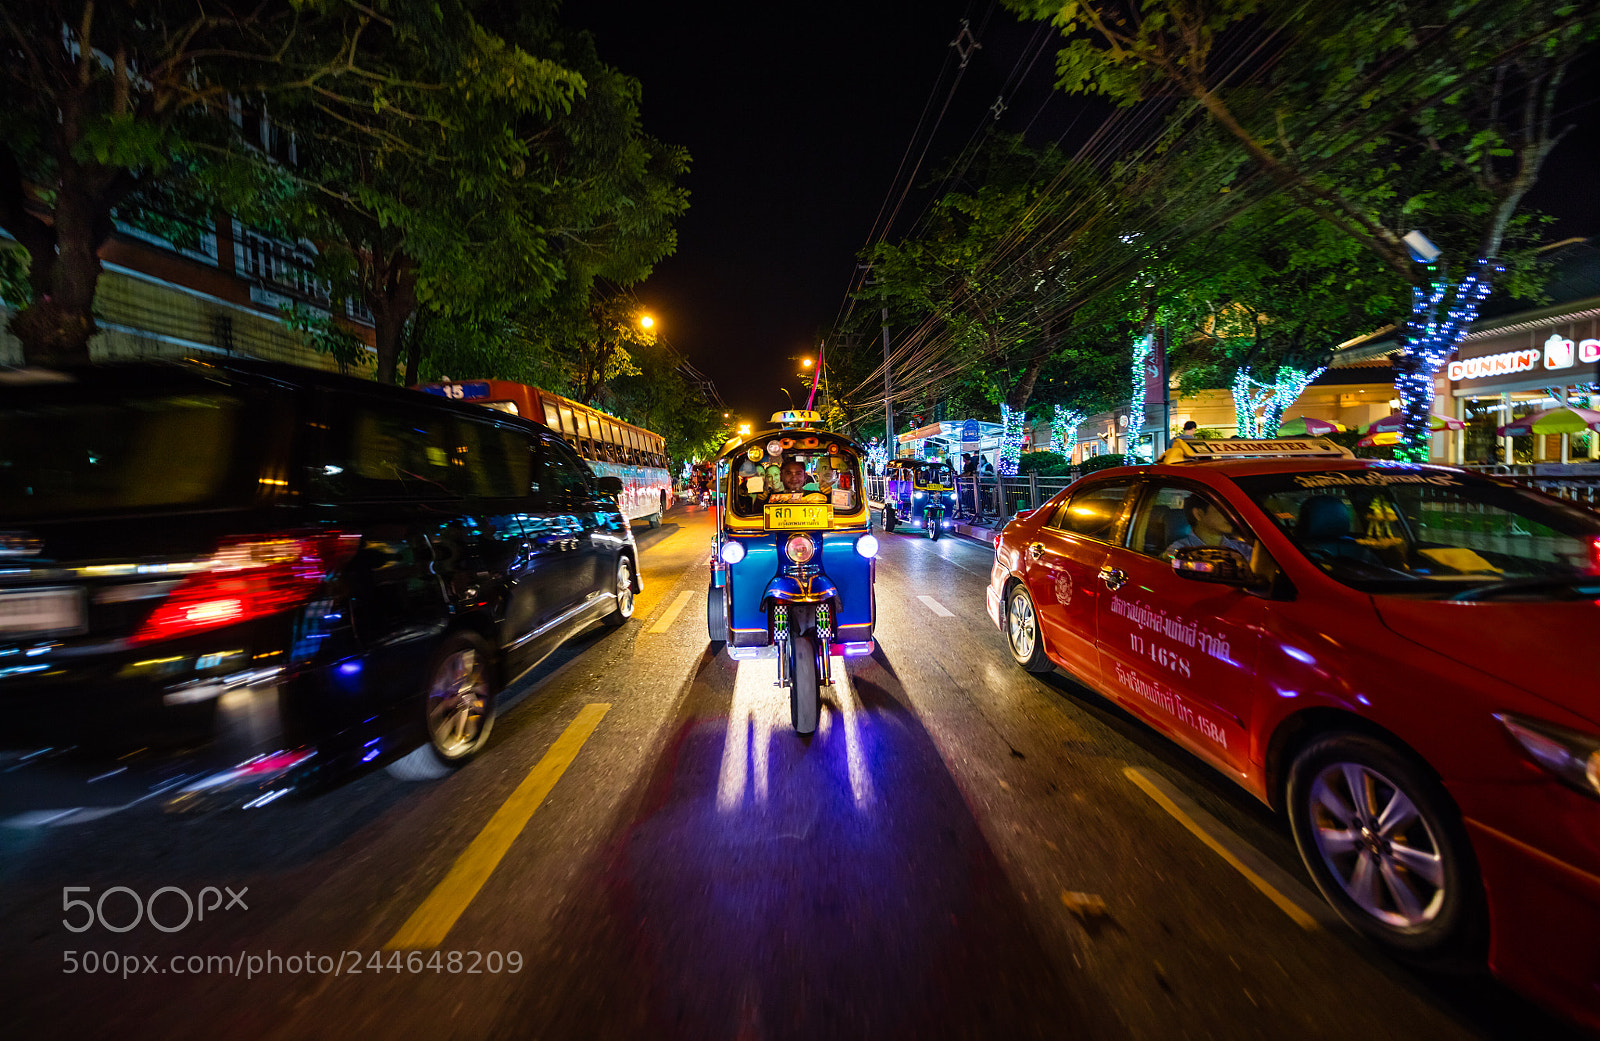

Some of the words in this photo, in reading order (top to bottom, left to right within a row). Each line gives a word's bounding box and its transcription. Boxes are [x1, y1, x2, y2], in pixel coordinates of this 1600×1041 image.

[1451, 352, 1538, 378] DUNKIN'
[442, 384, 464, 398] 15
[1211, 441, 1312, 452] TAXIMETER
[775, 507, 791, 518] สก
[1148, 643, 1191, 679] 4678
